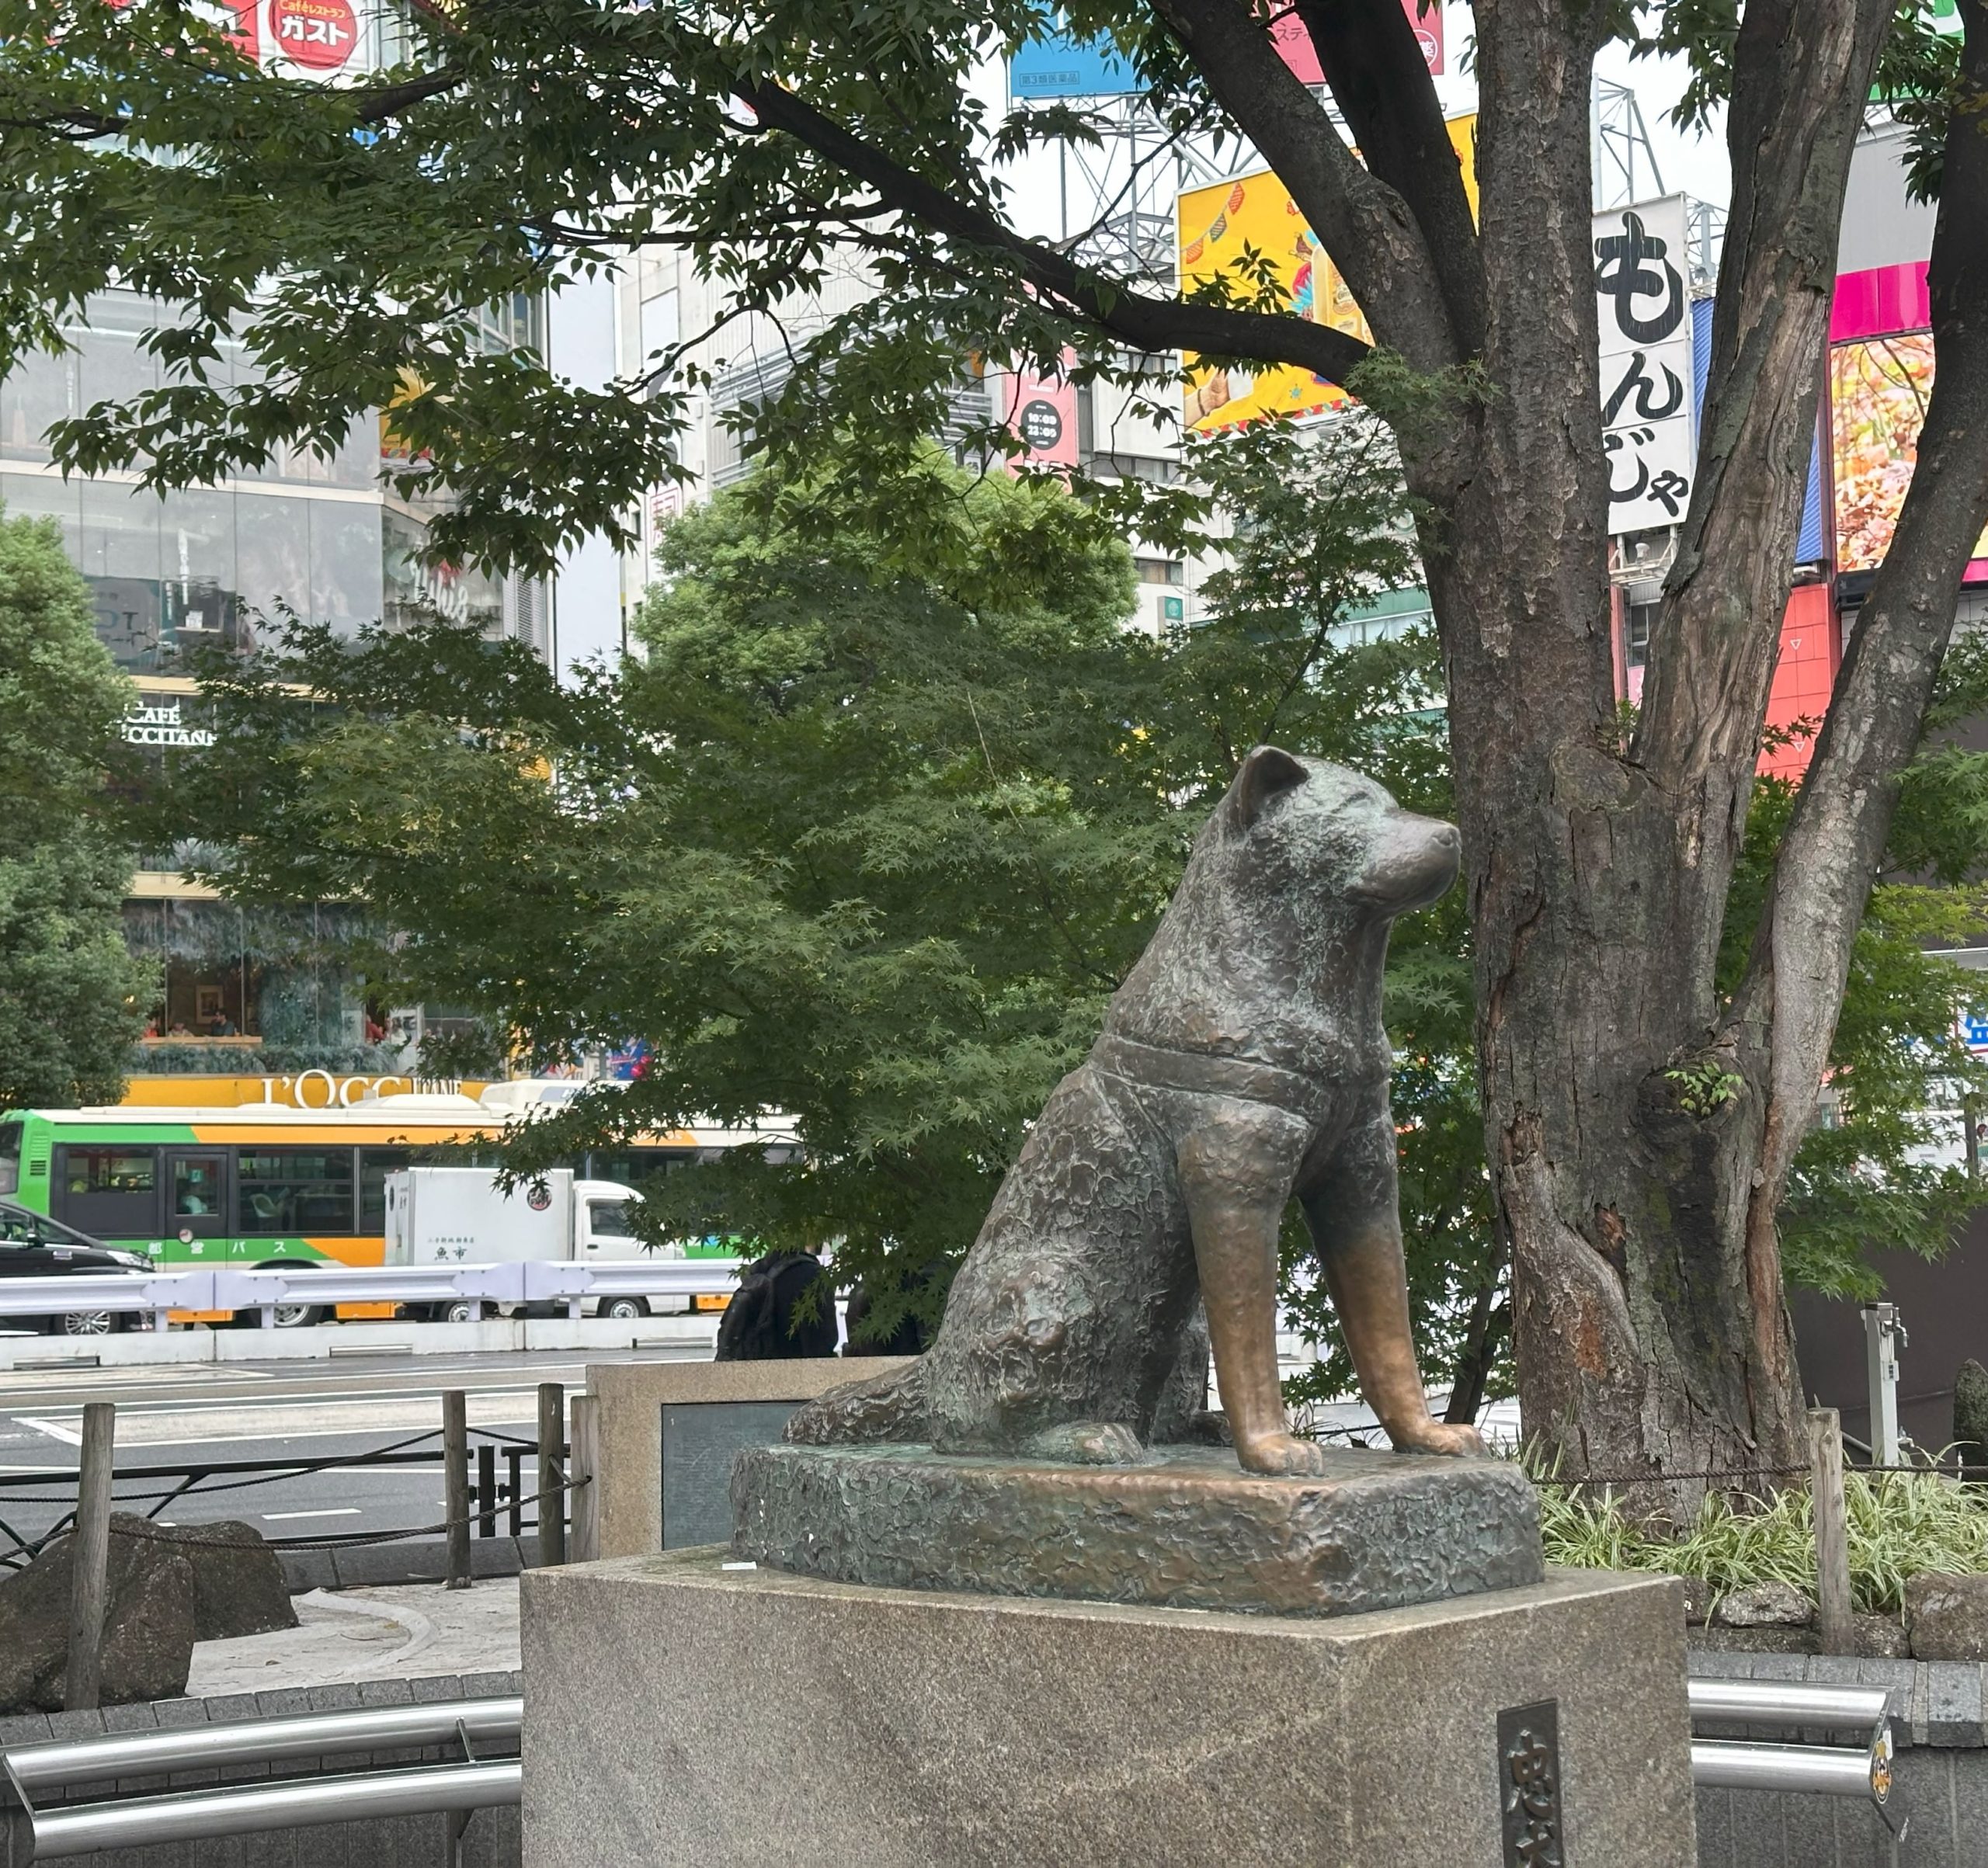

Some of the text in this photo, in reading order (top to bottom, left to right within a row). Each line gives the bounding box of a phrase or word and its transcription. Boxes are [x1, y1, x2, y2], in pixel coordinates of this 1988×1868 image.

[280, 16, 349, 46] ガスト
[1594, 211, 1689, 517] もんじゃ
[148, 1241, 287, 1255] 都営バス
[434, 1245, 467, 1261] 魚市
